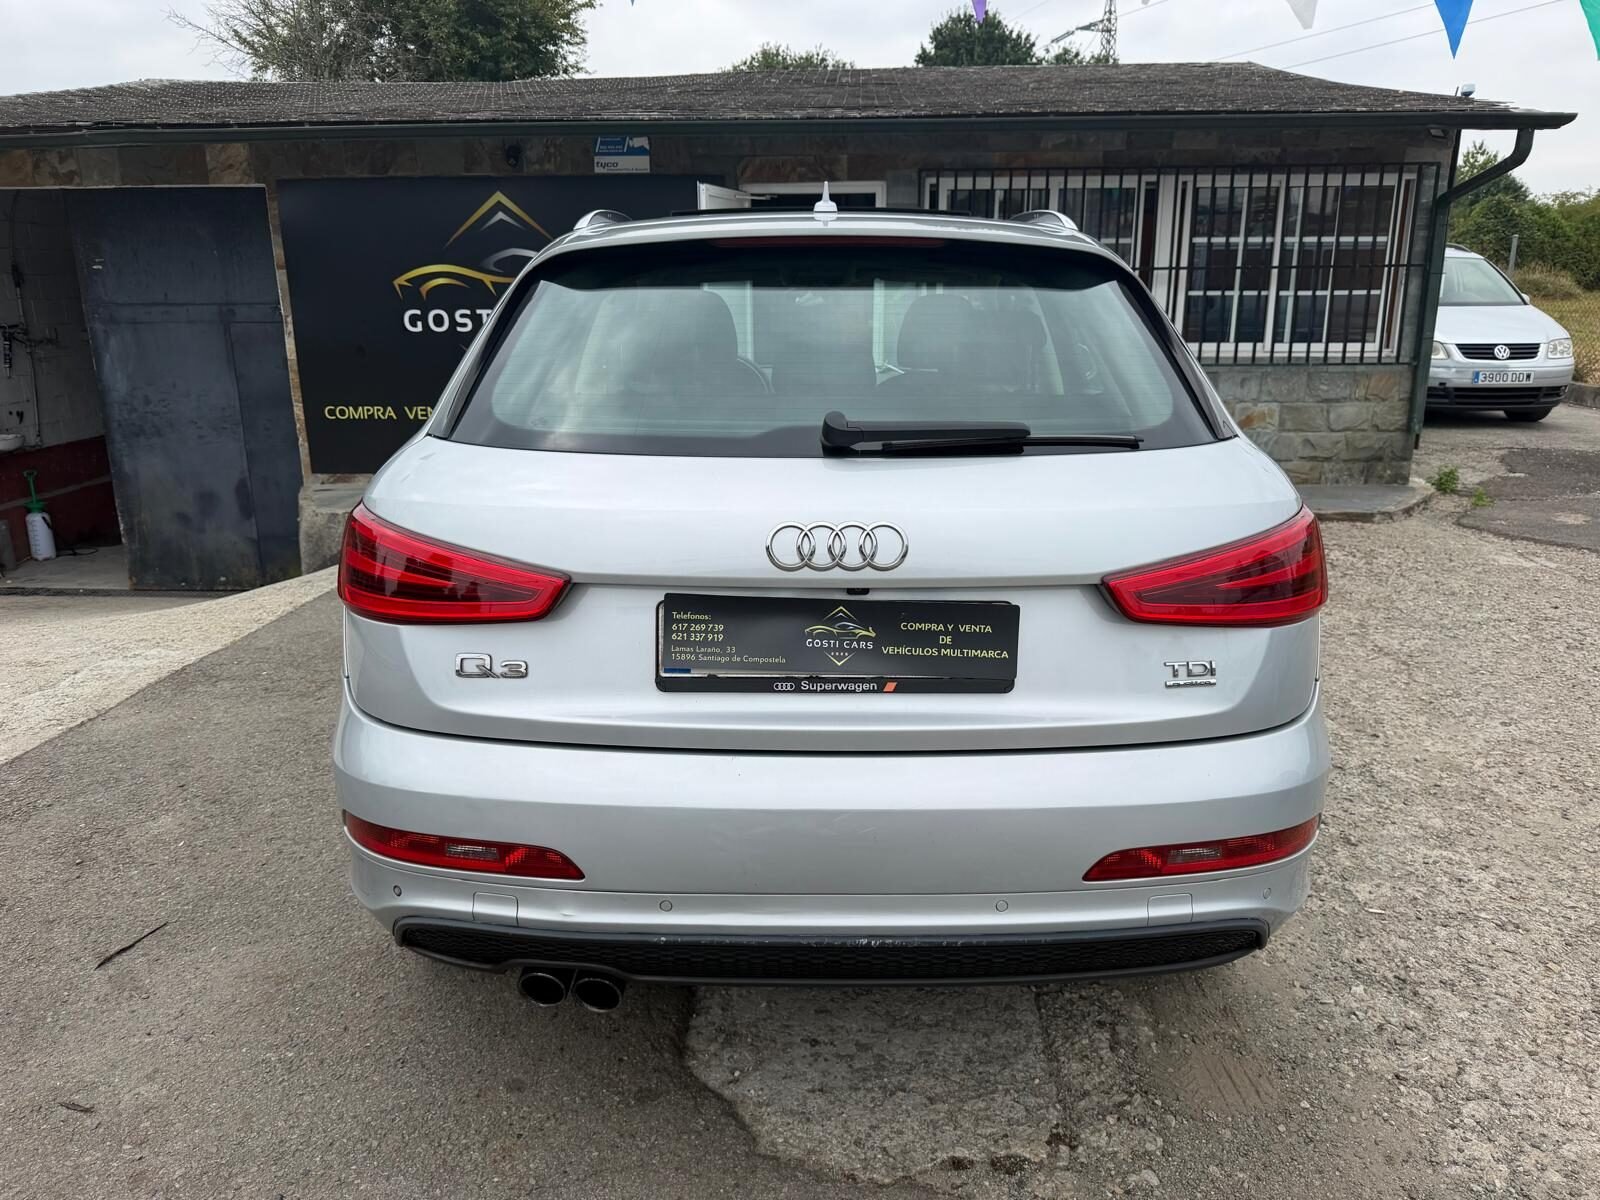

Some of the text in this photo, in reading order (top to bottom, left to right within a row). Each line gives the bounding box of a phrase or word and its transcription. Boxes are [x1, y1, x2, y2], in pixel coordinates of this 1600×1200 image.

[596, 160, 618, 169] tyco
[1481, 373, 1508, 383] 3900
[324, 406, 397, 419] COMPRA
[671, 623, 724, 632] 617 269 739
[901, 622, 945, 632] COMPRA
[959, 624, 993, 633] VENTA
[671, 632, 687, 640] 621
[708, 634, 724, 642] 919
[939, 635, 952, 644] DE
[806, 639, 873, 649] GOSTI CARS
[882, 646, 1009, 658] VEHÍCULOS MULTIMARCA
[698, 654, 730, 663] Santiago
[743, 655, 786, 664] Compostela
[455, 652, 528, 679] Q3
[1163, 660, 1216, 678] TDI
[801, 680, 877, 692] Superwagen
